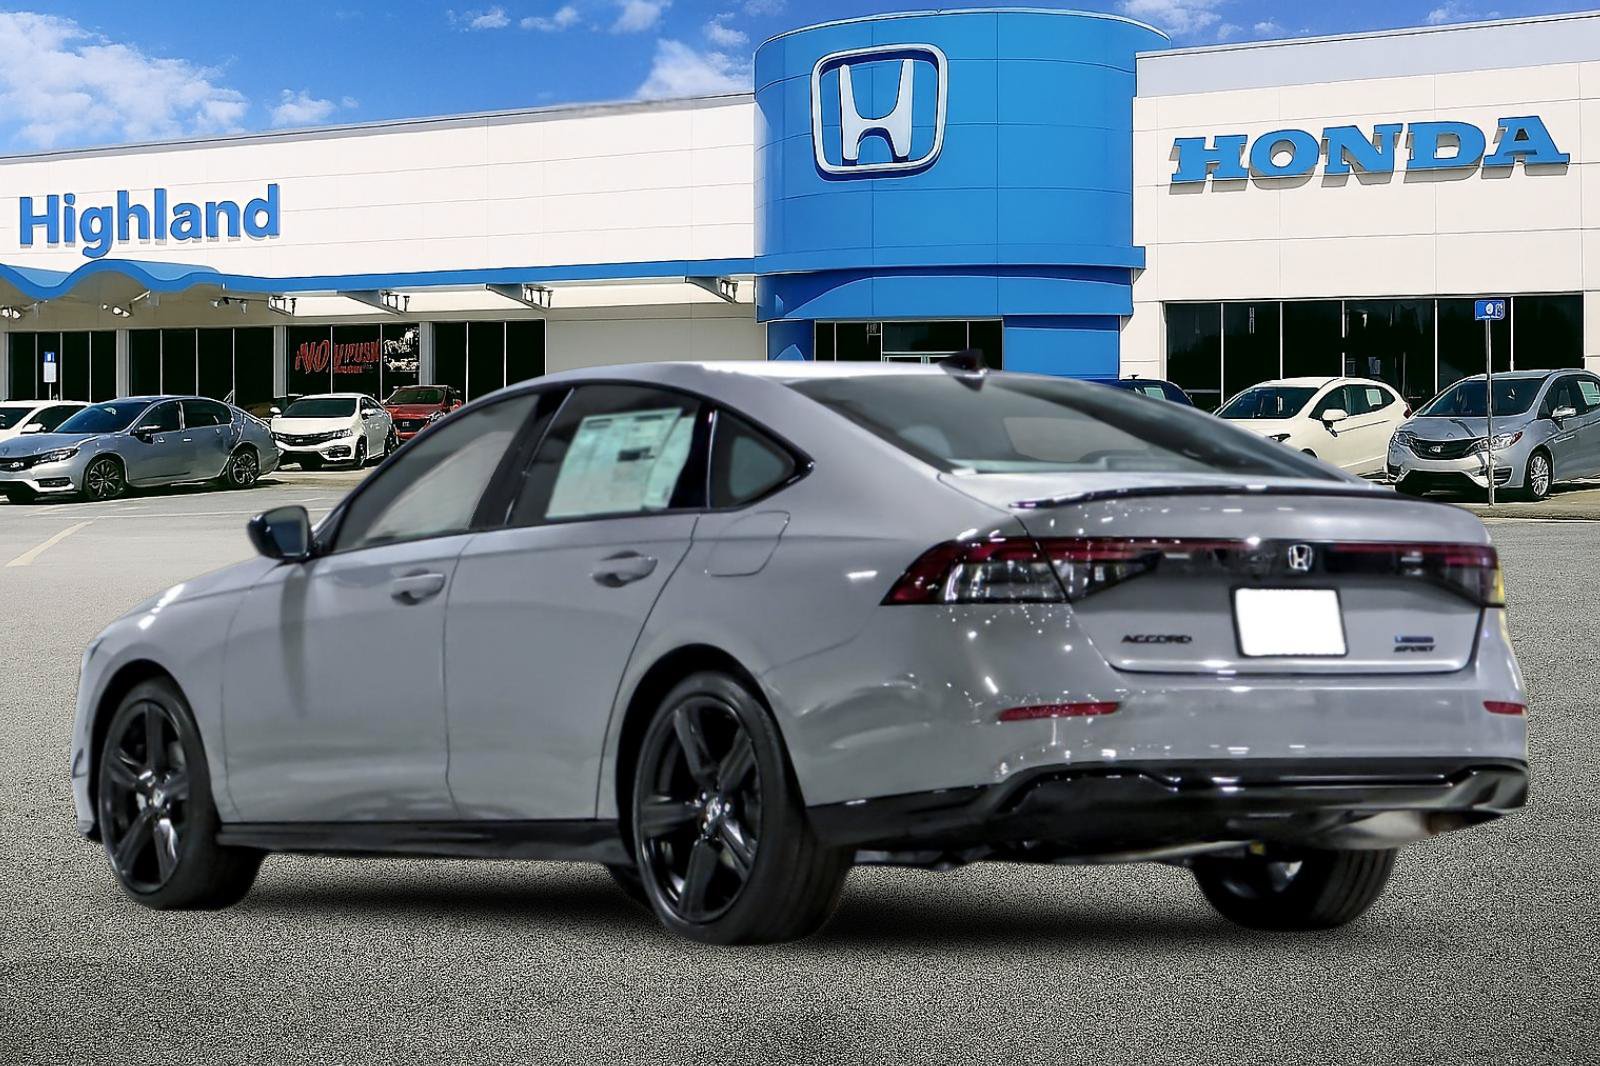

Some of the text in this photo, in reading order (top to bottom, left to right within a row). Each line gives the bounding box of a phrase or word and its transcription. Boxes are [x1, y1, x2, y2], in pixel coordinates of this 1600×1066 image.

[1171, 115, 1570, 182] HONDA
[19, 184, 280, 258] Highland
[1121, 634, 1193, 644] ACCORD
